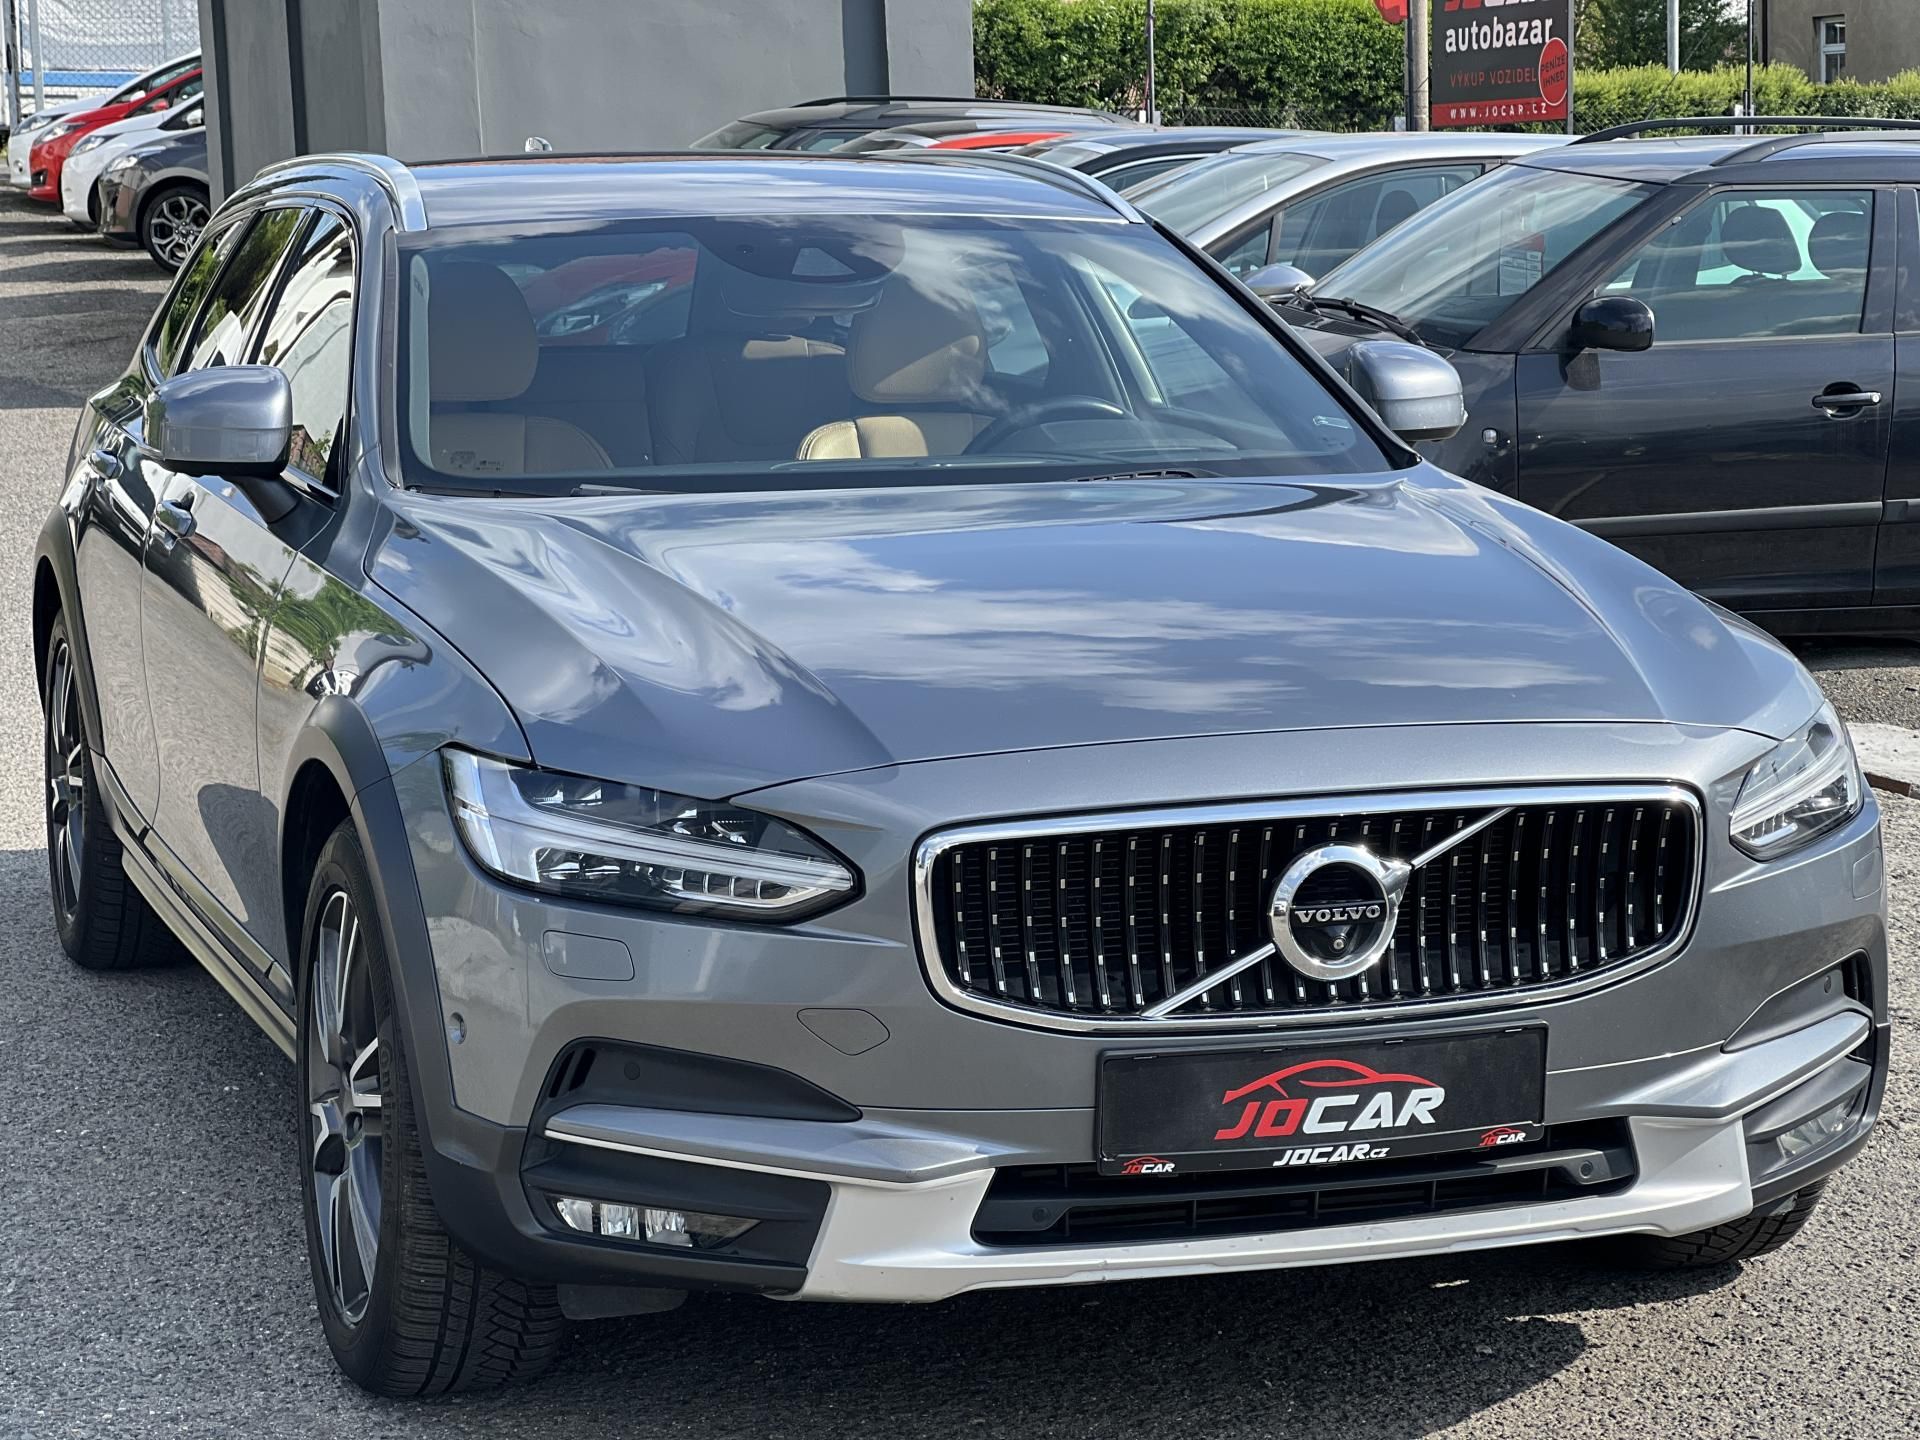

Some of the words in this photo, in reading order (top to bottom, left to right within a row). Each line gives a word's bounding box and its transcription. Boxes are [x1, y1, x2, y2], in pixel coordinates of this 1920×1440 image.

[1445, 16, 1553, 53] autobazar
[1450, 69, 1485, 88] VÝKUP
[1489, 67, 1537, 85] VOZIDEL
[1450, 102, 1548, 119] WWW.JOCAR.CZ
[1294, 905, 1380, 923] VOLVO
[1214, 1087, 1445, 1140] JOCAR
[1479, 1132, 1527, 1146] JOCAR
[1121, 1163, 1176, 1174] JOCAR
